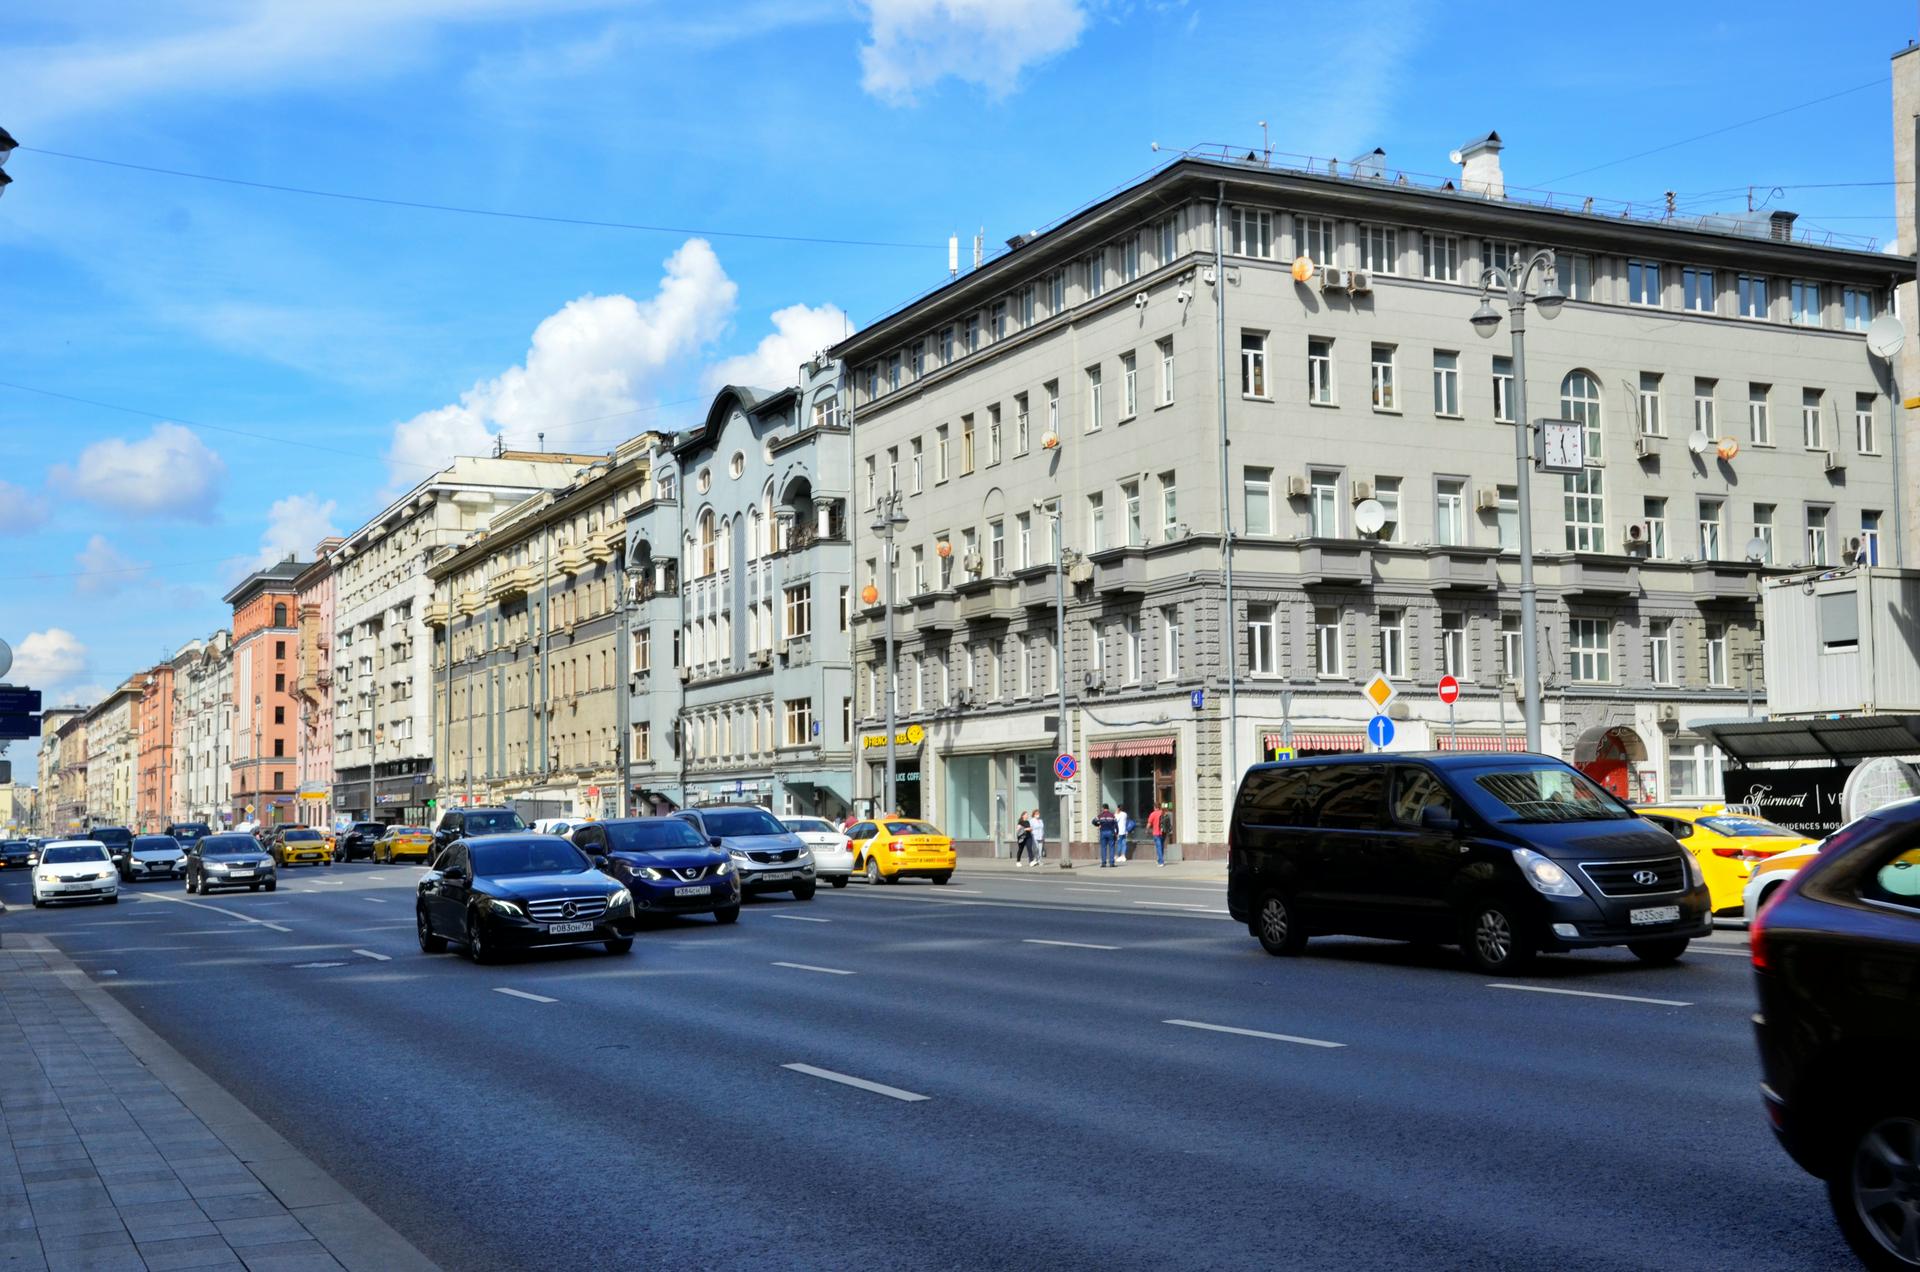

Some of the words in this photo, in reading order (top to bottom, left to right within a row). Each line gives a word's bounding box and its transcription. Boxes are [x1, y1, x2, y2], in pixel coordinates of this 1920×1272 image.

[1743, 784, 1808, 807] Fairmont
[1827, 792, 1844, 805] VE
[1776, 822, 1820, 830] ESIDENCES
